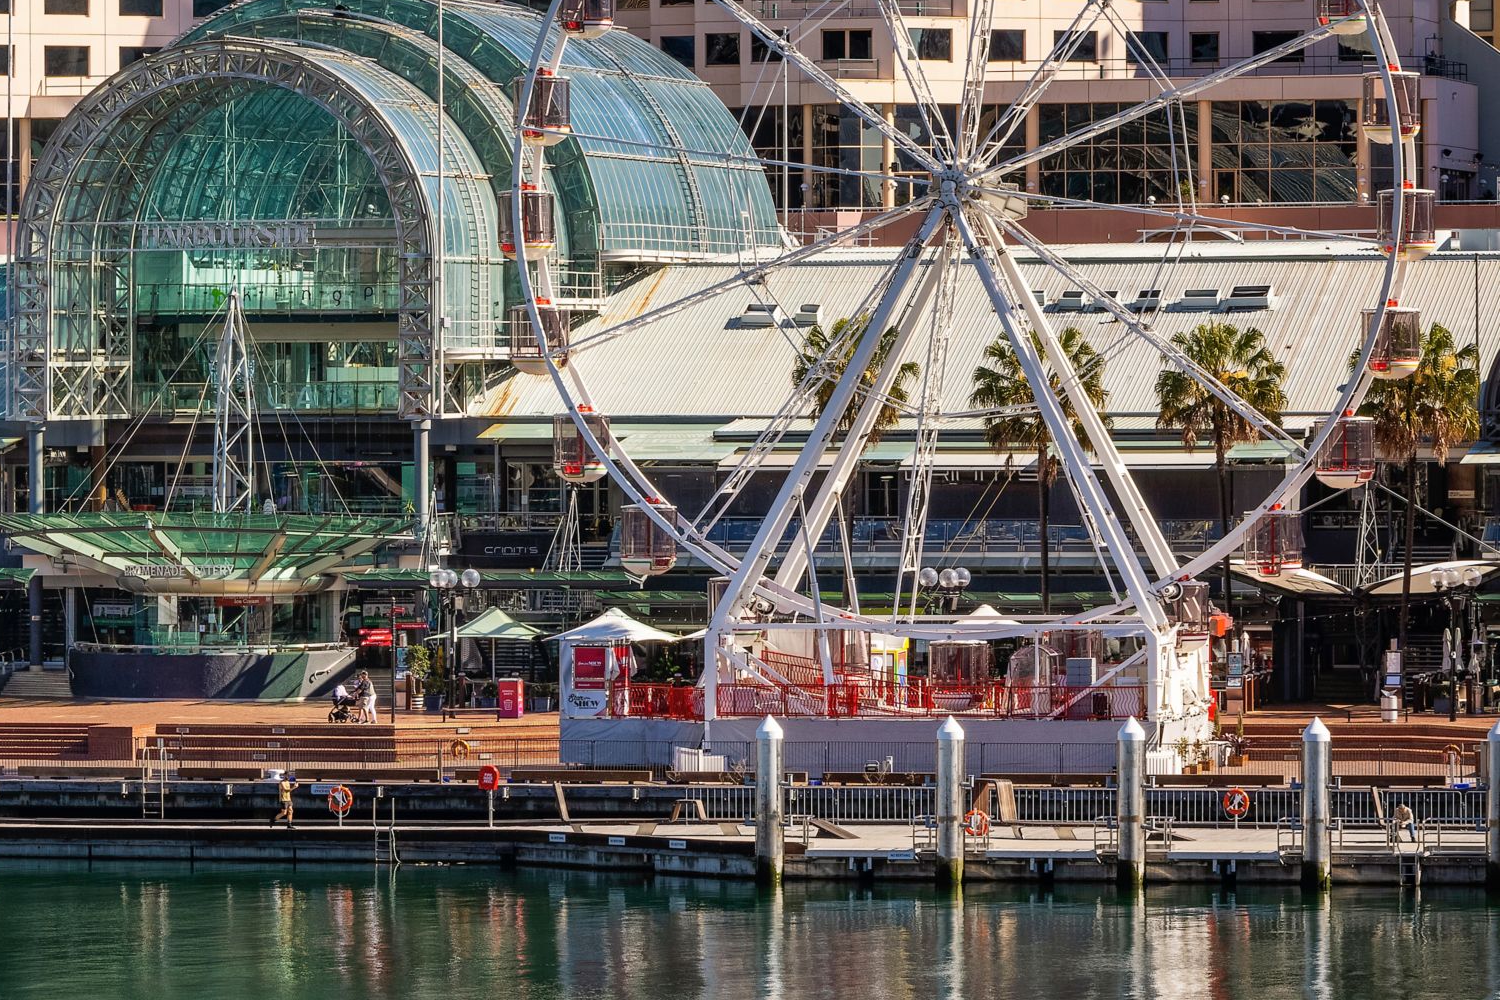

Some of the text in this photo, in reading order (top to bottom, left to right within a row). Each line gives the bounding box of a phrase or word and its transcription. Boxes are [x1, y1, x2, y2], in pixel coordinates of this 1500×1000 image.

[138, 222, 315, 248] HARBOURSIDE
[124, 564, 235, 577] PROMENADE EATERY
